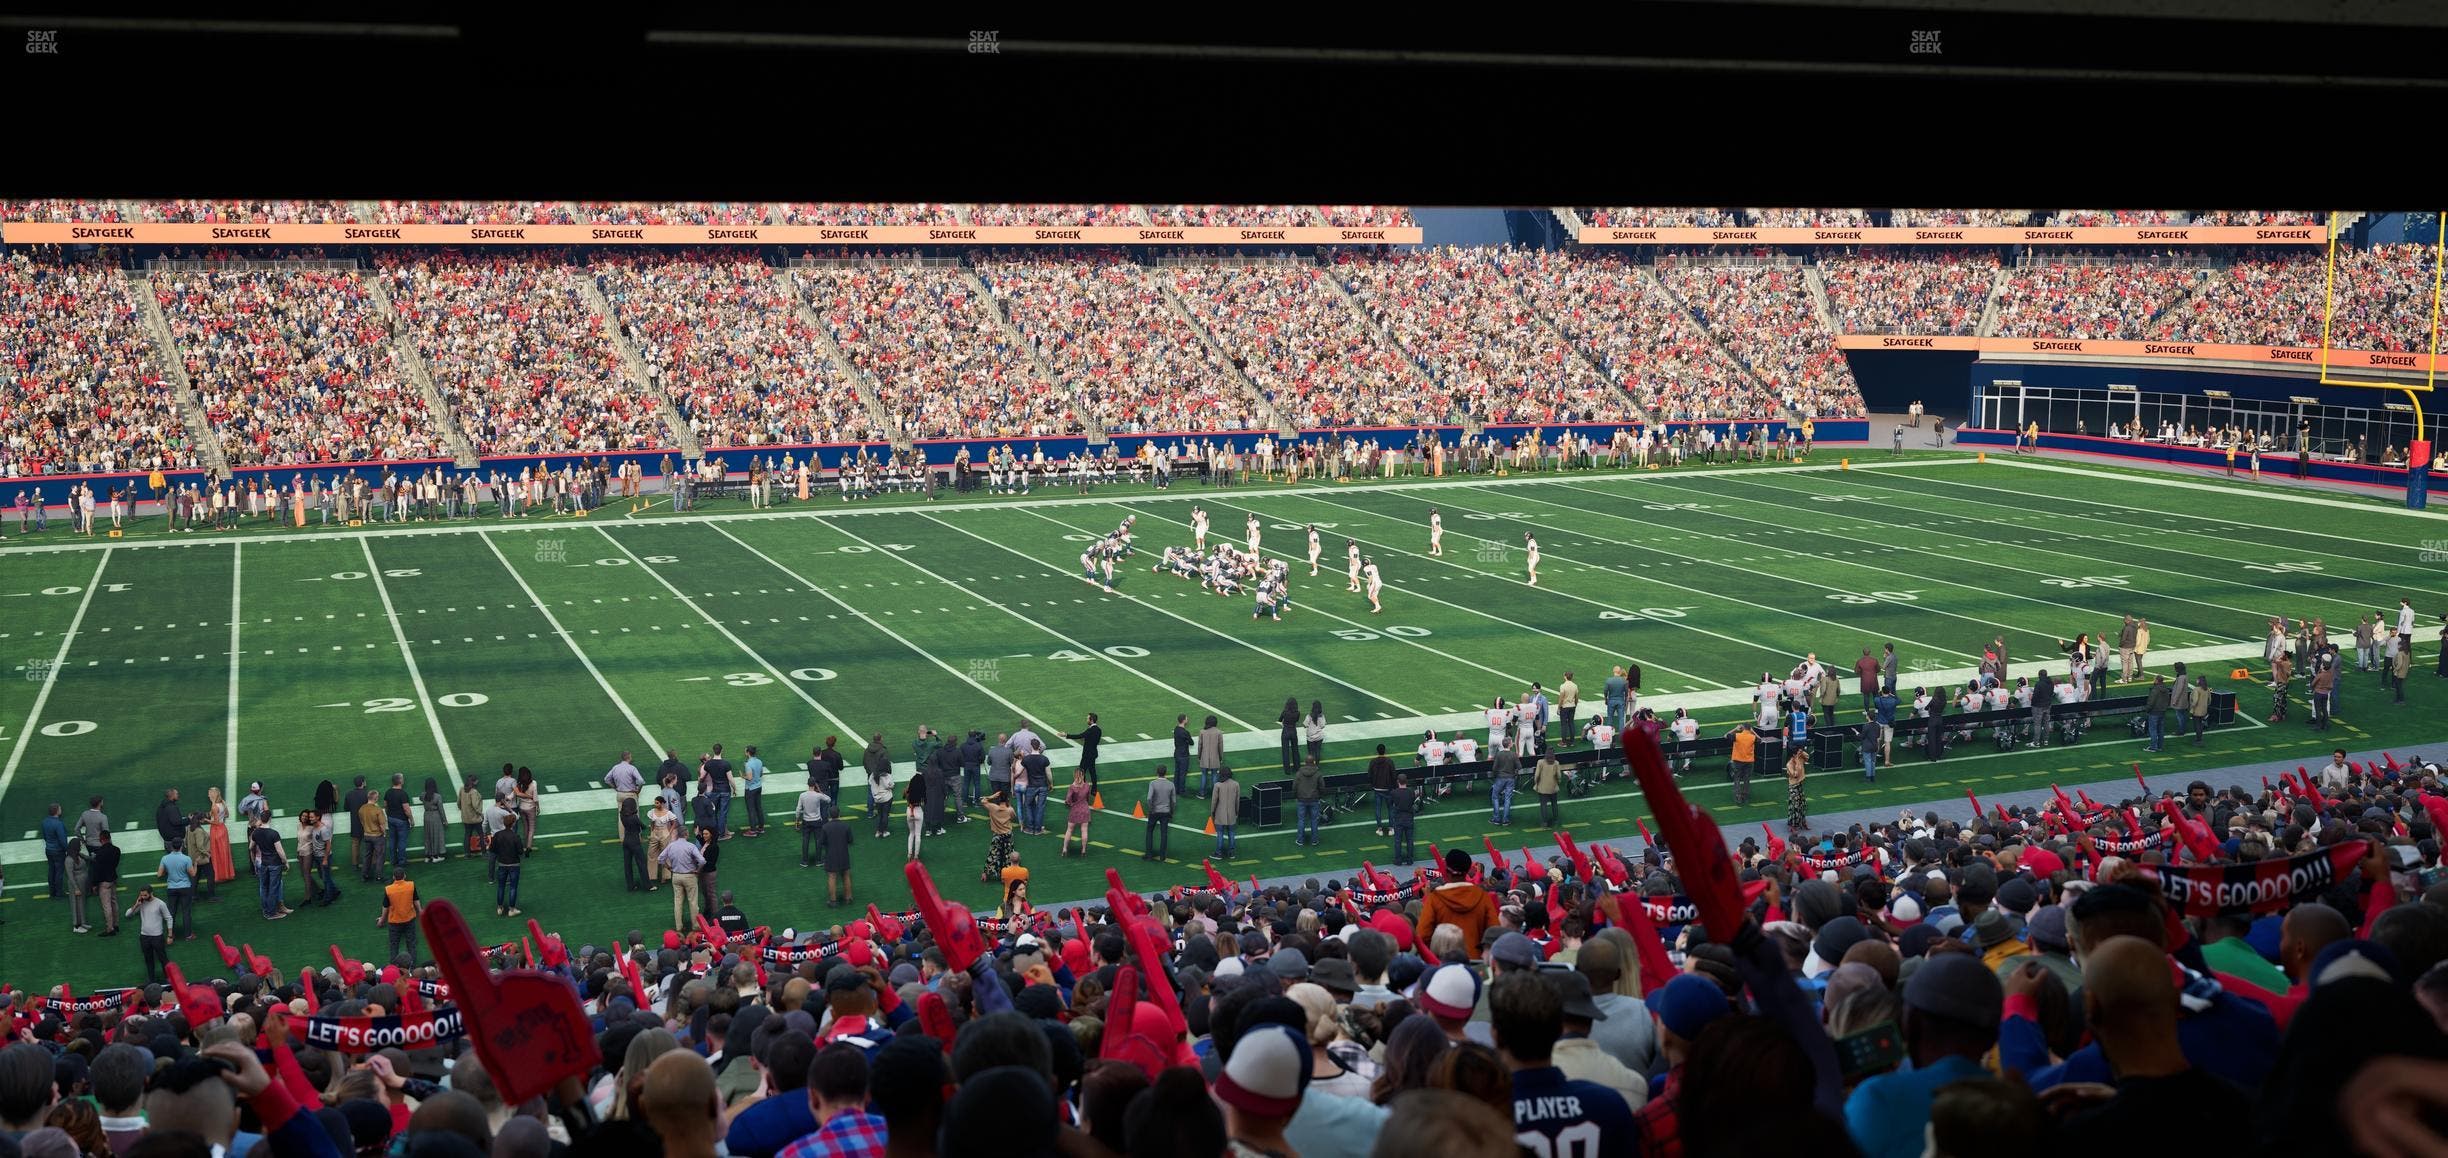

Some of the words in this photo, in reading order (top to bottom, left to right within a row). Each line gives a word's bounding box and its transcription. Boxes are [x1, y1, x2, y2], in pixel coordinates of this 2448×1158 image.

[71, 227, 135, 239] SEATGEEK
[211, 227, 272, 239] SEATGEEK
[344, 228, 401, 239] SEATGEEK
[471, 228, 525, 240] SEATGEEK
[592, 228, 644, 240] SEATGEEK
[708, 229, 758, 240] SEATGEEK
[820, 229, 869, 240] SEATGEEK
[929, 229, 977, 240] SEATGEEK
[1035, 230, 1081, 240] SEATGEEK
[1139, 230, 1185, 240] SEATGEEK
[1240, 230, 1285, 240] SEATGEEK
[1341, 230, 1385, 240] SEATGEEK
[1612, 231, 1657, 240] SEATGEEK
[1712, 231, 1758, 240] SEATGEEK
[1815, 231, 1862, 240] SEATGEEK
[1915, 231, 1963, 240] SEATGEEK
[2024, 230, 2074, 240] SEATGEEK
[2137, 230, 2189, 240] SEATGEEK
[2256, 229, 2312, 240] SEATGEEK
[1883, 338, 1933, 348] SEATGEEK
[2032, 341, 2082, 352] SEATGEEK
[2144, 344, 2196, 356] SEATGEEK
[2270, 348, 2314, 361] SEATGEEK
[2369, 354, 2417, 367] SEATGEEK
[1328, 625, 1432, 640] 50
[1047, 645, 1151, 662] 40
[722, 667, 838, 687] 30
[362, 692, 489, 714] 20
[2158, 870, 2212, 906] LET'S
[2216, 855, 2332, 907] GOOOOO!!!
[1353, 891, 1372, 902] LET'S
[1641, 902, 1665, 921] T'S
[763, 947, 787, 961] LET'S
[788, 941, 839, 961] GOOOOO!!!
[419, 981, 449, 997] LET'S
[46, 998, 71, 1012] LET'S
[72, 993, 122, 1012] GOOOOO!!!
[308, 1019, 360, 1047] LET'S
[363, 1010, 464, 1047] GOOOOO!!
[1514, 1095, 1583, 1125] PLAYER
